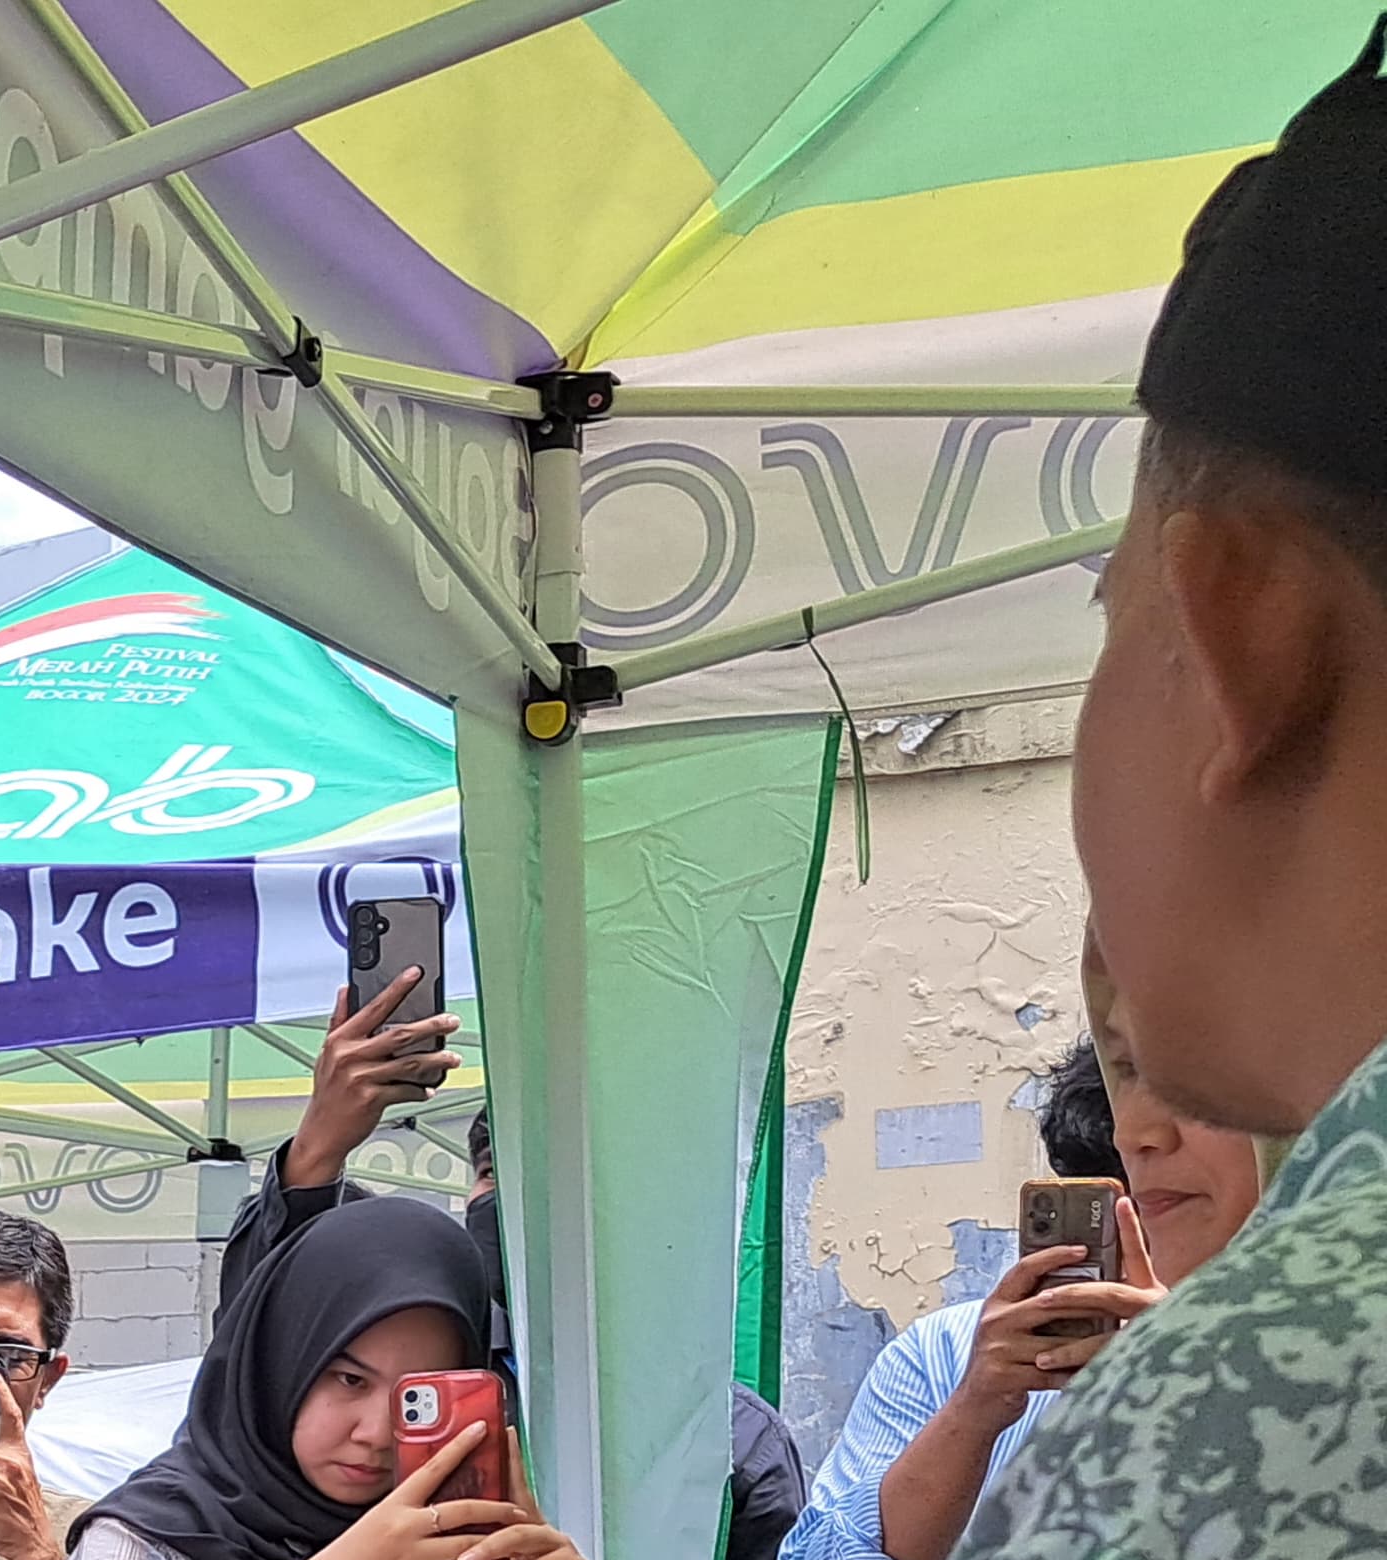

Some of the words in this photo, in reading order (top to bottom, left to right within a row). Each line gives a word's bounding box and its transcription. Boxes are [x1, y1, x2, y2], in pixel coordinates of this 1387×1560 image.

[102, 643, 221, 665] FESTIVAL
[8, 658, 117, 677] MERAH
[117, 660, 213, 680] PUTIH
[25, 689, 106, 702] BOGOR
[112, 690, 188, 706] 2024
